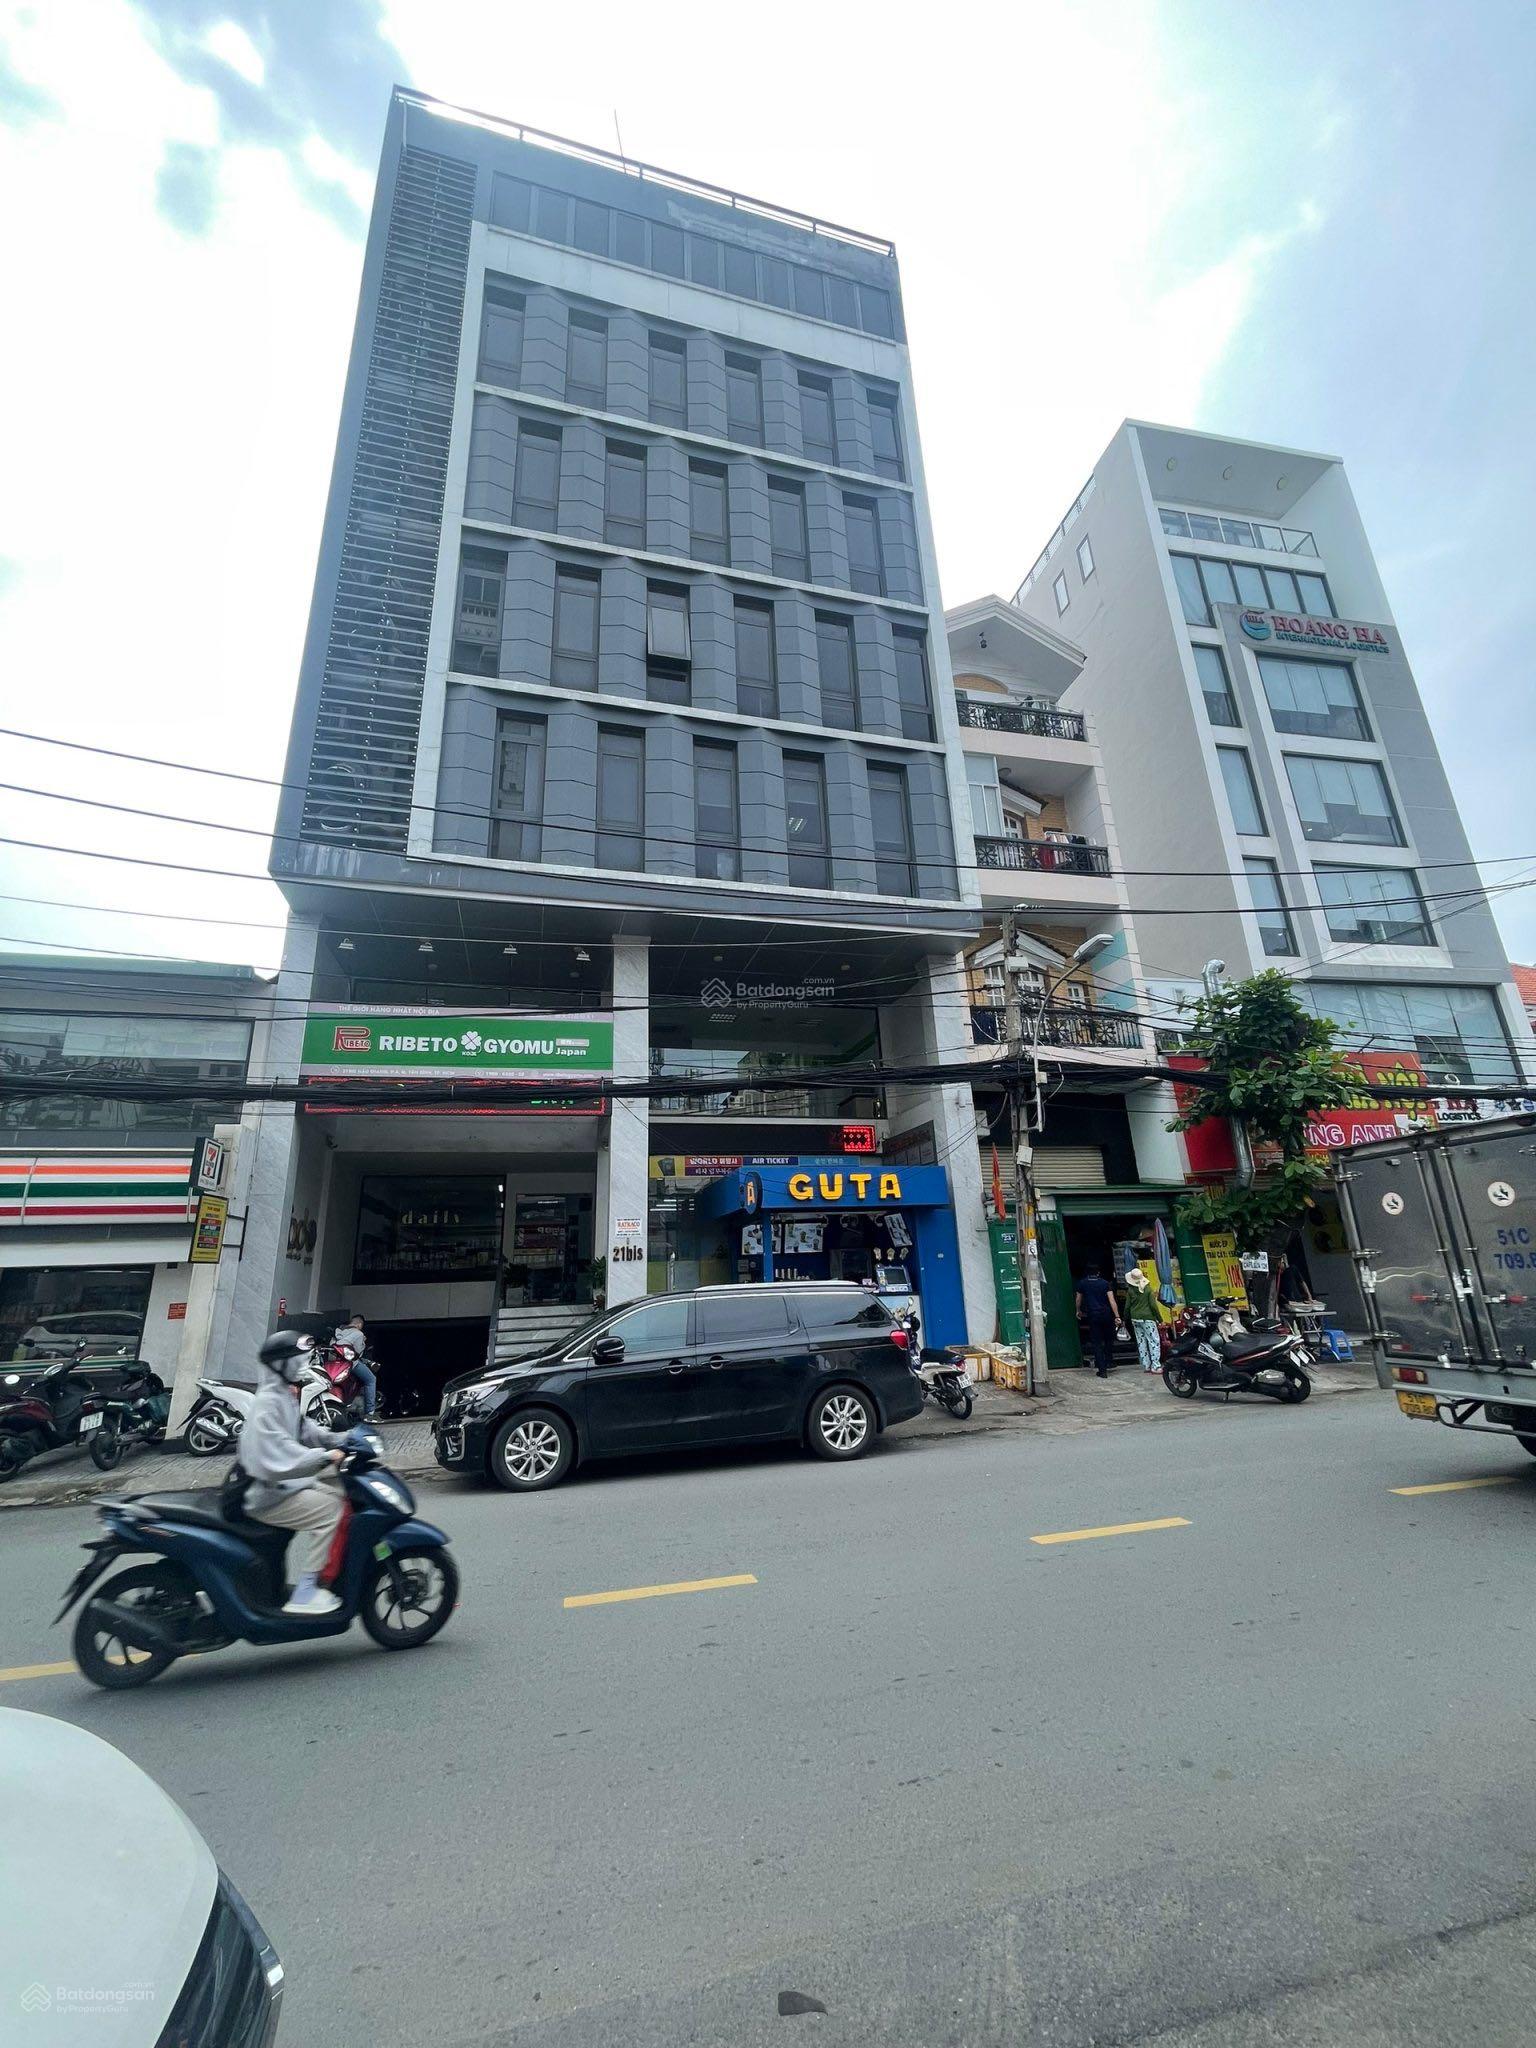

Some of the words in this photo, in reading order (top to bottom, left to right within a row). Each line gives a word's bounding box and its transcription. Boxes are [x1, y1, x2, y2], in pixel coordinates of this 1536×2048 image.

[1271, 616, 1349, 640] HOANG
[1353, 627, 1387, 645] HA
[1276, 633, 1345, 648] INTERNATIONAL
[1345, 640, 1390, 653] LOGISTICS
[380, 1035, 458, 1053] RIBETO
[484, 1038, 554, 1055] GYOMU
[555, 1047, 587, 1057] Japan
[1436, 1112, 1482, 1122] LOGISTICS
[1351, 1124, 1396, 1145] ANH
[752, 1157, 765, 1165] AIR
[766, 1157, 789, 1165] TICKET
[788, 1173, 902, 1200] GUTA
[1497, 1228, 1530, 1245] 51C
[613, 1245, 644, 1262] 21bis
